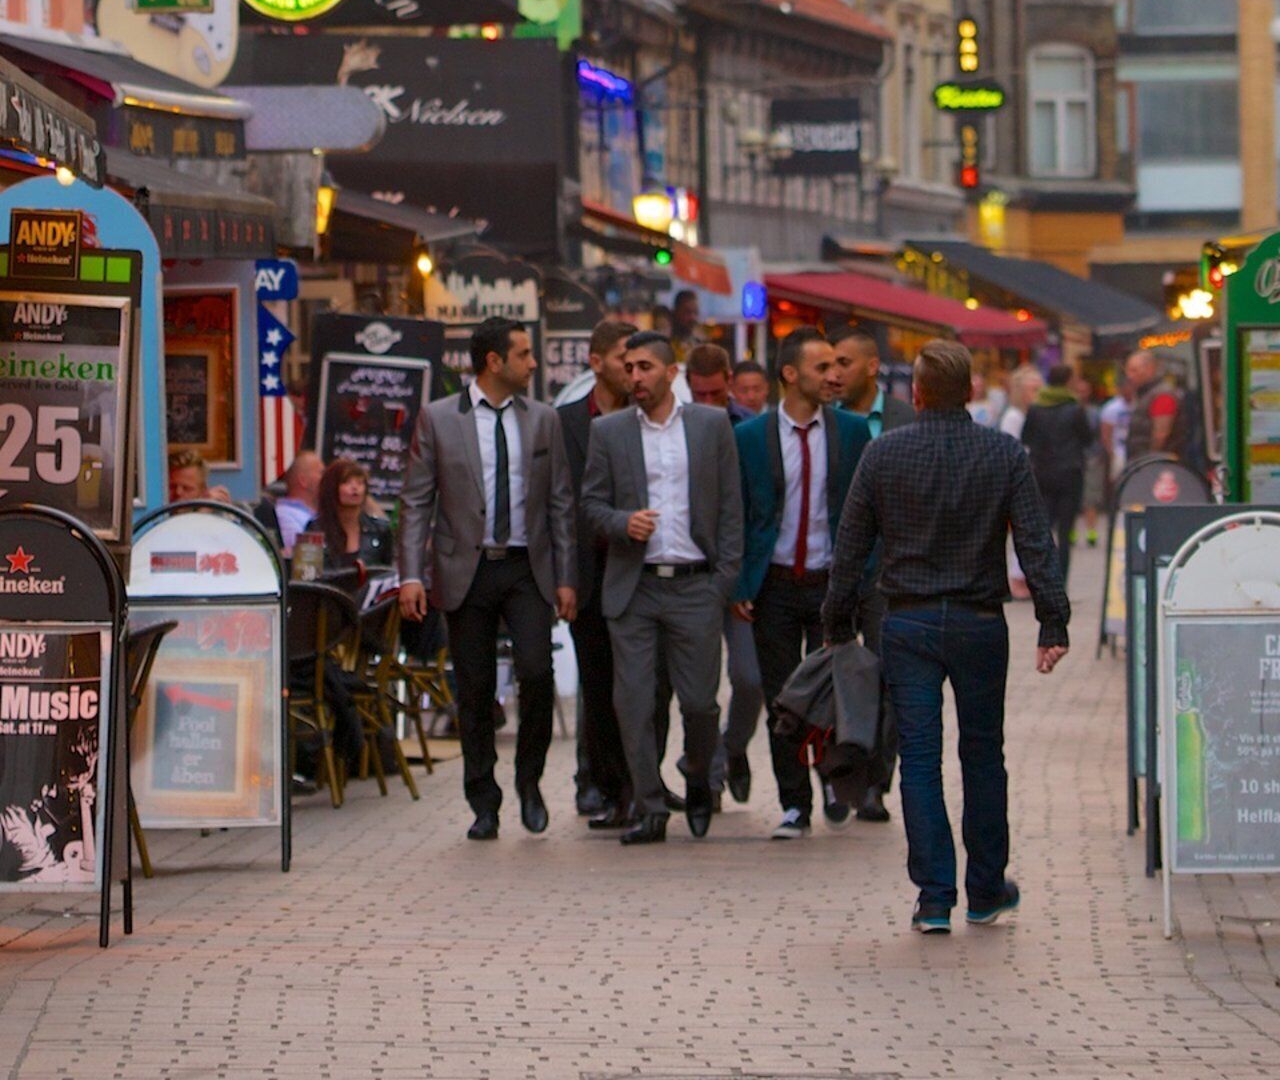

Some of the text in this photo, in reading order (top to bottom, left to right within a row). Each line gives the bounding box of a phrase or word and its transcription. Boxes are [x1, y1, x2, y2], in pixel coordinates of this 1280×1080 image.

[27, 253, 71, 265] Heineken
[55, 381, 79, 393] Cold
[0, 684, 99, 720] Music
[18, 722, 30, 735] at
[1239, 733, 1254, 744] Vis
[1240, 779, 1259, 794] 10
